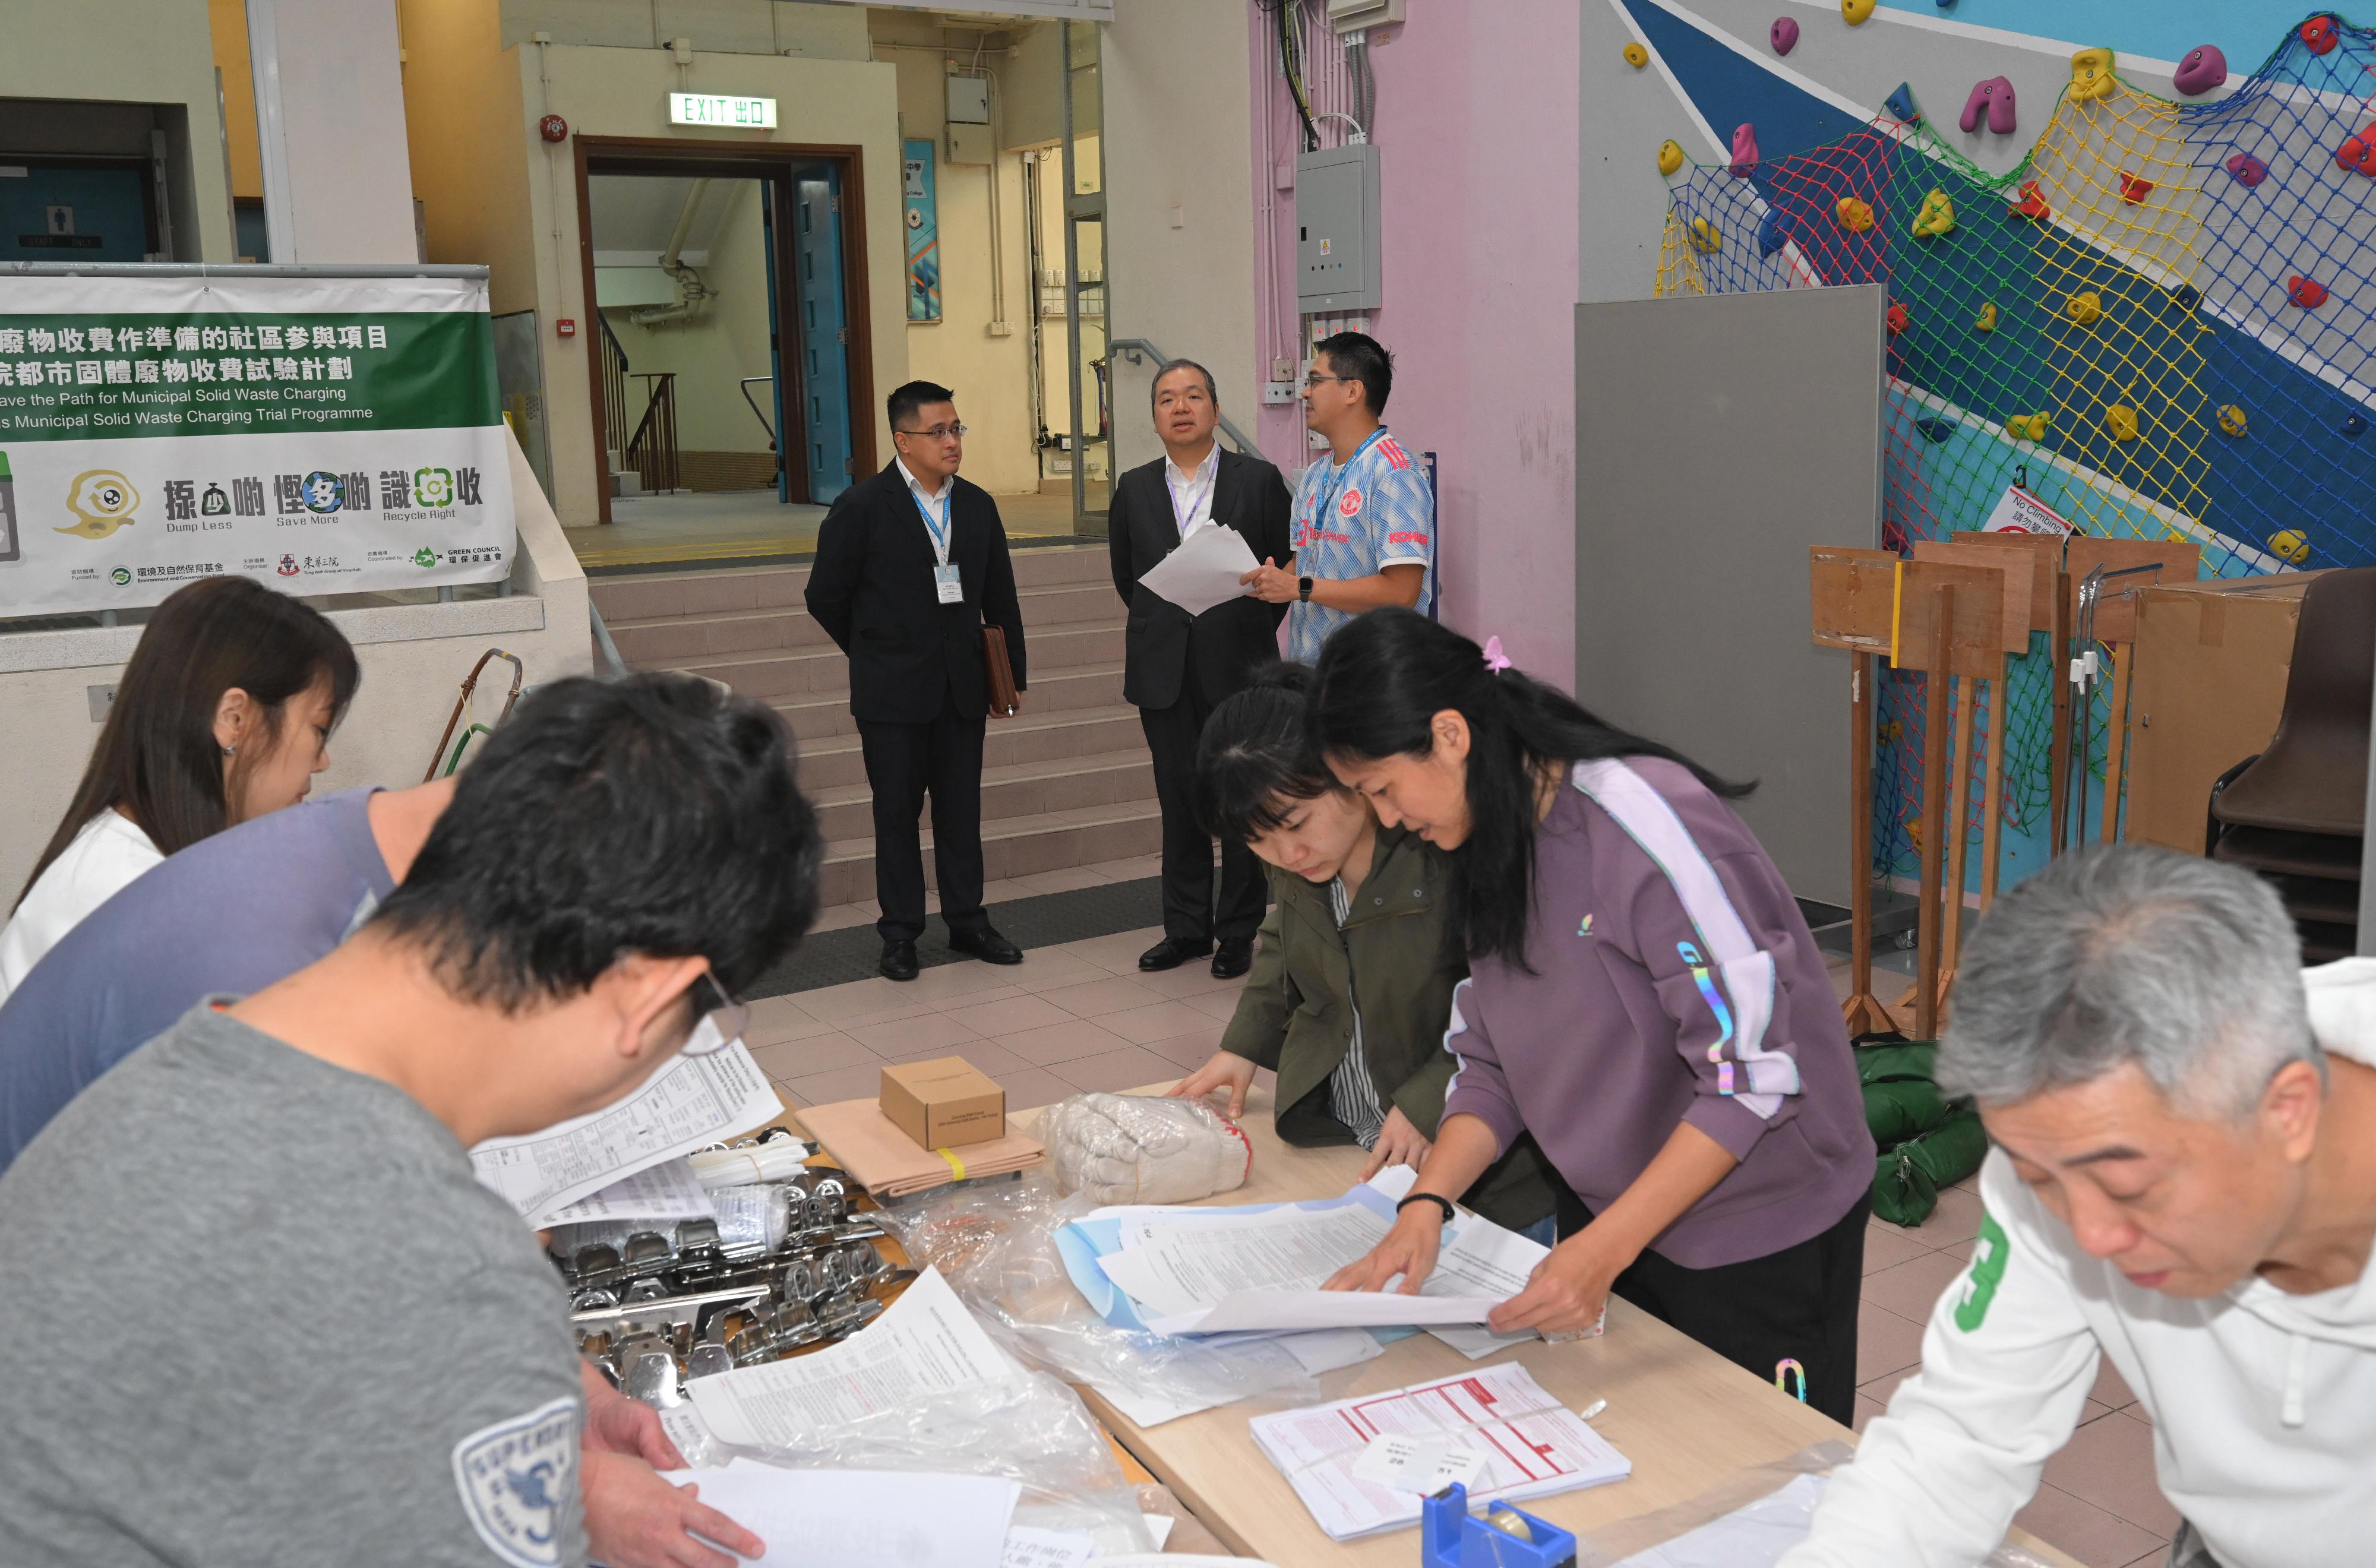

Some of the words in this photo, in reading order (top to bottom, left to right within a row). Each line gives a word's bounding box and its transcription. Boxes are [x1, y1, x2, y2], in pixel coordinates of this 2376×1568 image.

[684, 98, 726, 122] EXIT
[735, 101, 763, 124] 出口
[905, 163, 921, 171] 中學
[0, 325, 387, 353] 廢物收費作準備的社區參與項目
[0, 356, 352, 386] 院都市固體廢物收費試驗計劃
[30, 393, 55, 406] the
[60, 393, 94, 405] Path
[99, 391, 118, 403] for
[122, 390, 190, 404] Municipal
[195, 388, 230, 402] Solid
[235, 388, 279, 400] Waste
[283, 387, 346, 402] Charging
[0, 419, 10, 428] s
[15, 414, 88, 429] Municipal
[93, 413, 130, 425] Solid
[135, 412, 182, 424] Waste
[187, 409, 251, 424] Charging
[256, 408, 286, 421] Trial
[292, 407, 372, 422] Programme
[277, 517, 307, 526] Save
[311, 515, 339, 524] More
[383, 511, 426, 521] Recycle
[430, 509, 456, 520] Right
[2013, 497, 2026, 508] No
[2027, 505, 2062, 534] Climbing
[167, 523, 198, 532] Dump
[203, 521, 232, 530] Less
[304, 556, 339, 569] 東華三院
[448, 553, 502, 564] 環保促進會
[137, 562, 223, 577] 環境及自然保育基金
